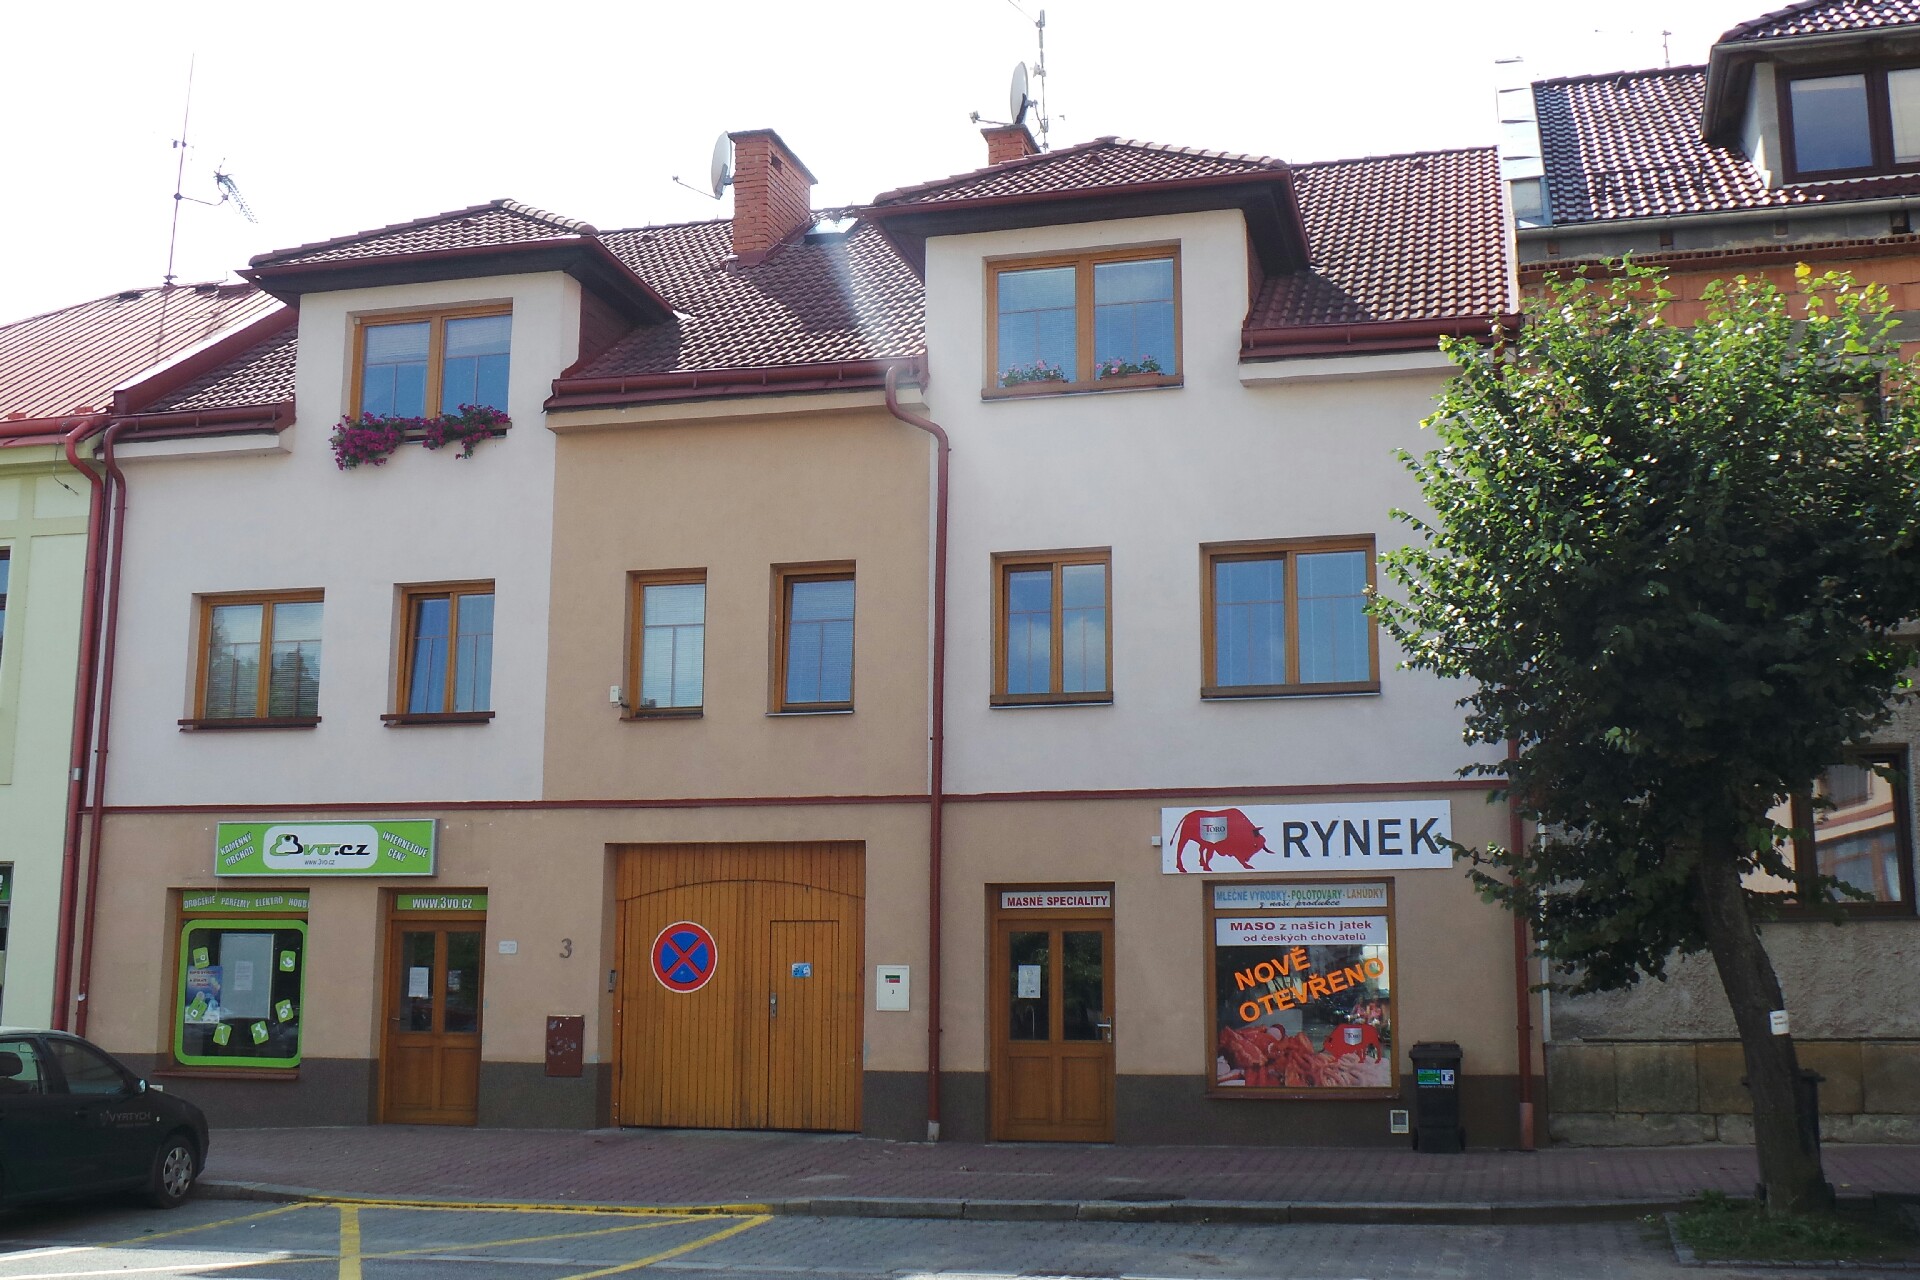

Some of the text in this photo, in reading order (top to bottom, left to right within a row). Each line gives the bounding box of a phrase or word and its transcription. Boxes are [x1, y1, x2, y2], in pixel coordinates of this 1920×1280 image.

[1283, 818, 1441, 858] RYNEK
[225, 846, 254, 866] OBCHOD
[387, 848, 407, 862] CENY
[1007, 895, 1108, 906] MASNÉ SPECIALITY
[1291, 889, 1342, 900] POLOTOVARY
[184, 895, 215, 908] DROGERIE
[255, 896, 283, 907] ELEKTRO
[412, 897, 473, 909] www.3vo.cz
[1295, 899, 1340, 908] produkce
[1230, 920, 1372, 931] MASO z našich jatek
[1243, 932, 1366, 943] od českých chovatelů
[559, 938, 573, 959] 3
[1234, 946, 1311, 991] NOVĚ
[1239, 957, 1384, 1022] OTEVŘENO
